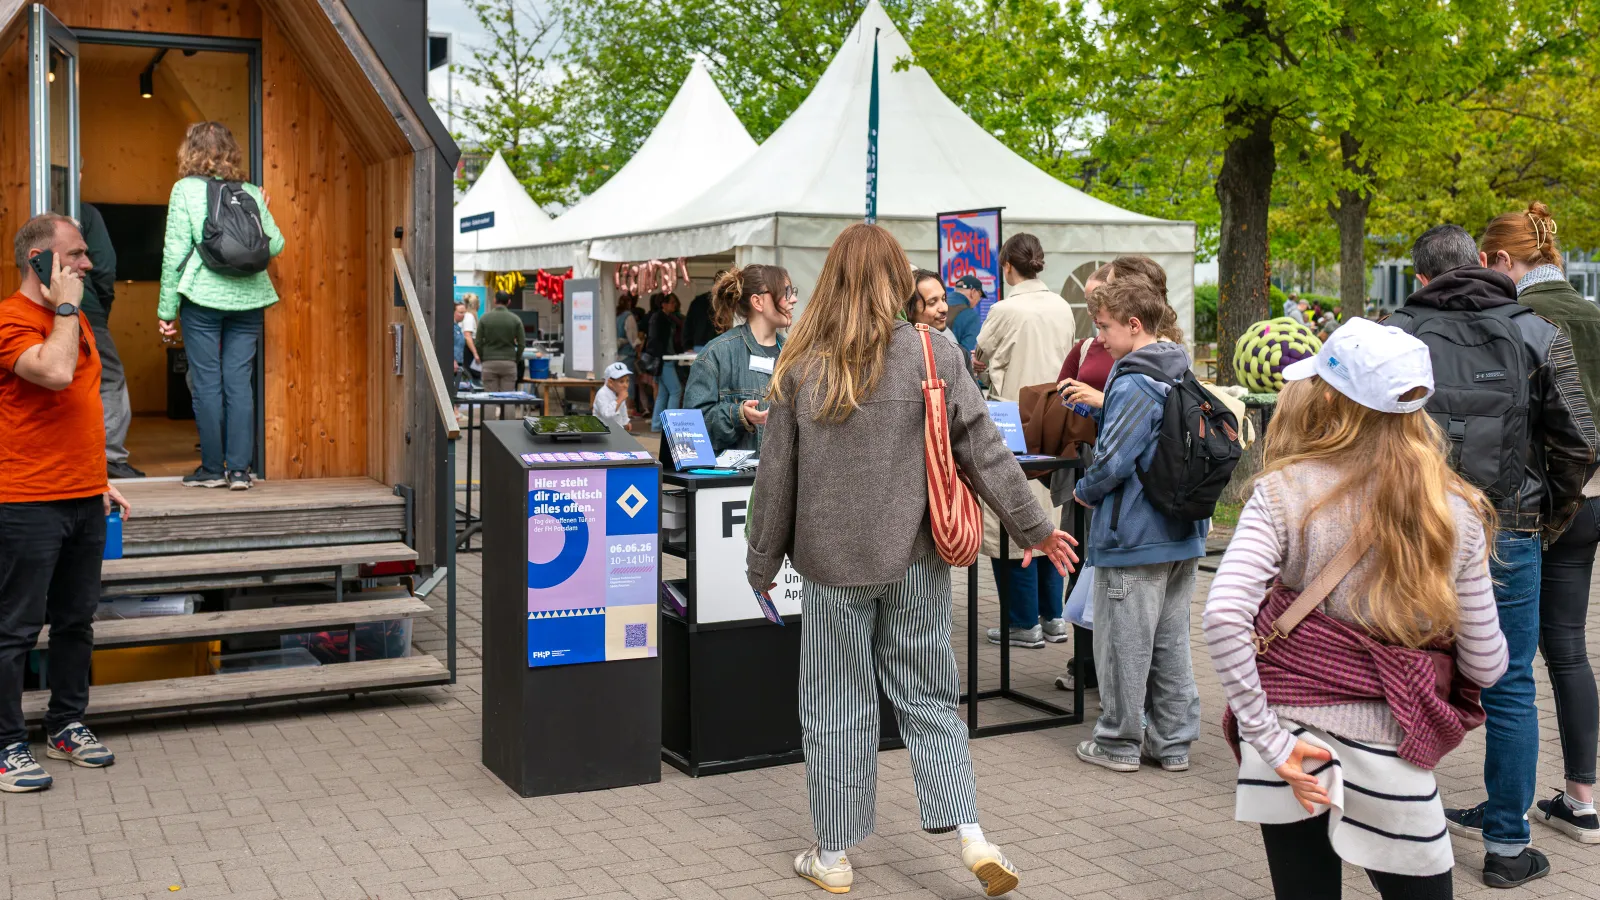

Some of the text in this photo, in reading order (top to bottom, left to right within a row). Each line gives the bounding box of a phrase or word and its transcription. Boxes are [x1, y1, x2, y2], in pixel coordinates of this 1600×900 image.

[942, 223, 990, 268] Textil
[534, 477, 588, 488] Hier steht
[534, 489, 602, 502] dir praktisch
[534, 502, 595, 514] alles offen.
[610, 543, 652, 553] 06.06.26
[638, 554, 655, 563] Uhr
